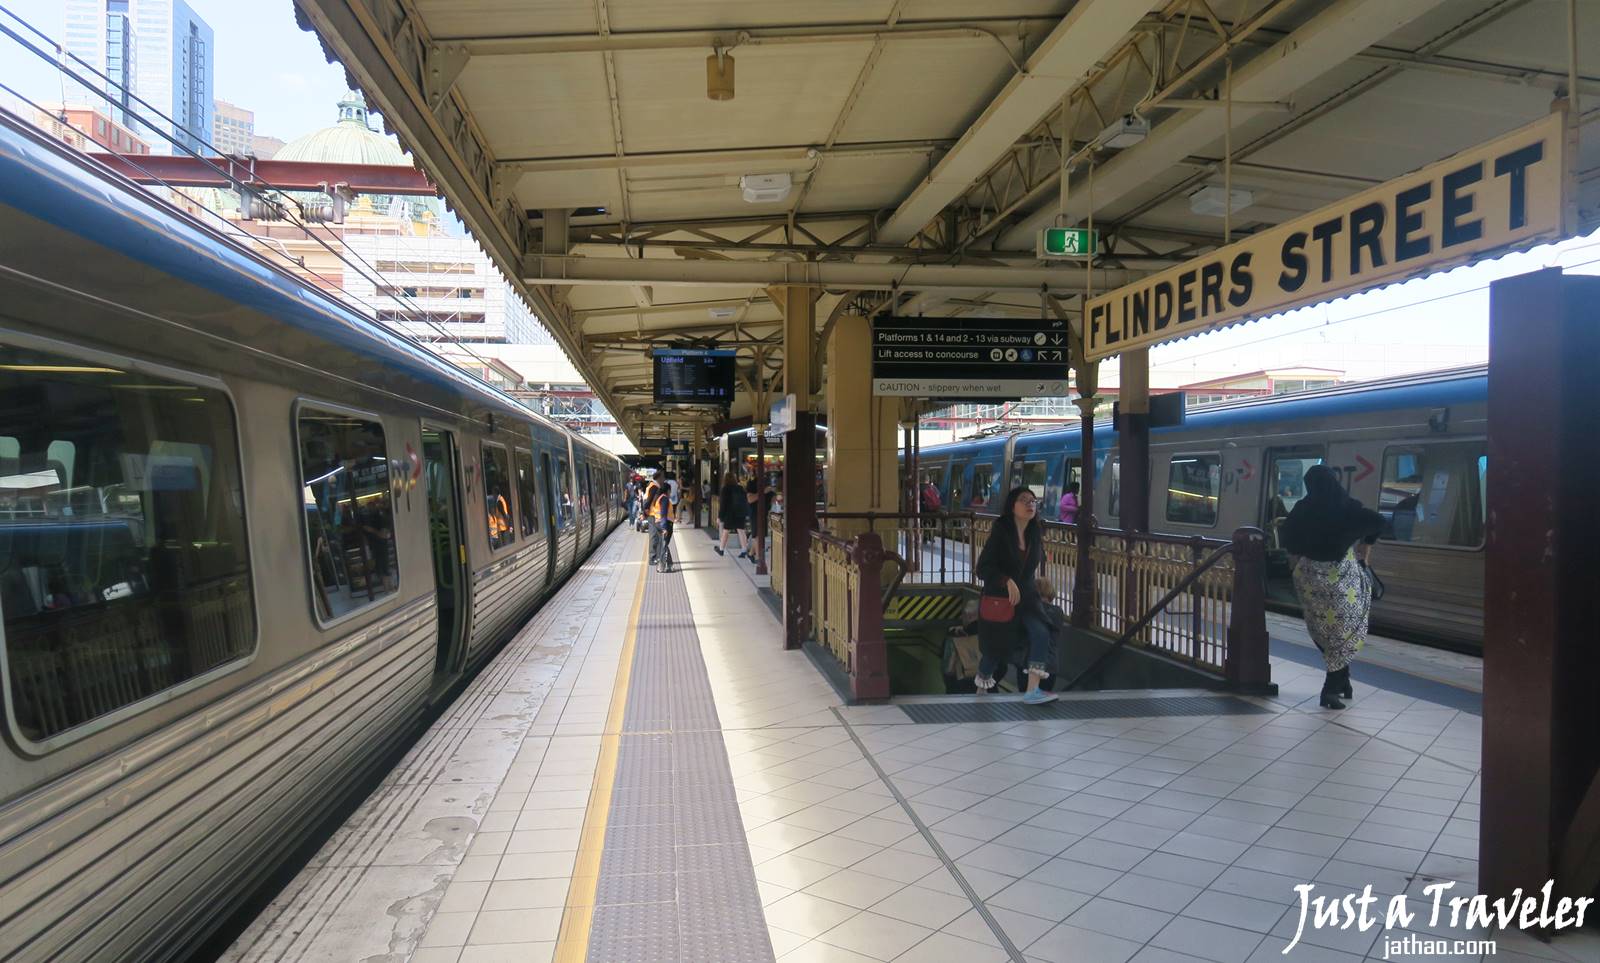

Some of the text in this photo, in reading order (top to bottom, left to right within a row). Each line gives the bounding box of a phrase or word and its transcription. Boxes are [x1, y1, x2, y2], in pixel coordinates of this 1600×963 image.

[1090, 140, 1543, 349] FLINDERS STREET
[878, 333, 918, 342] Platforms
[920, 334, 924, 342] 1
[926, 334, 933, 342] &
[935, 334, 944, 342] 14
[946, 335, 961, 343] and
[963, 334, 969, 343] 2
[976, 334, 986, 343] 13
[987, 335, 999, 343] via
[1000, 335, 1031, 344] subway
[879, 350, 892, 358] Lift
[880, 383, 920, 391] CAUTION
[928, 384, 960, 393] slippery
[962, 384, 985, 392] when
[986, 384, 1001, 392] wet
